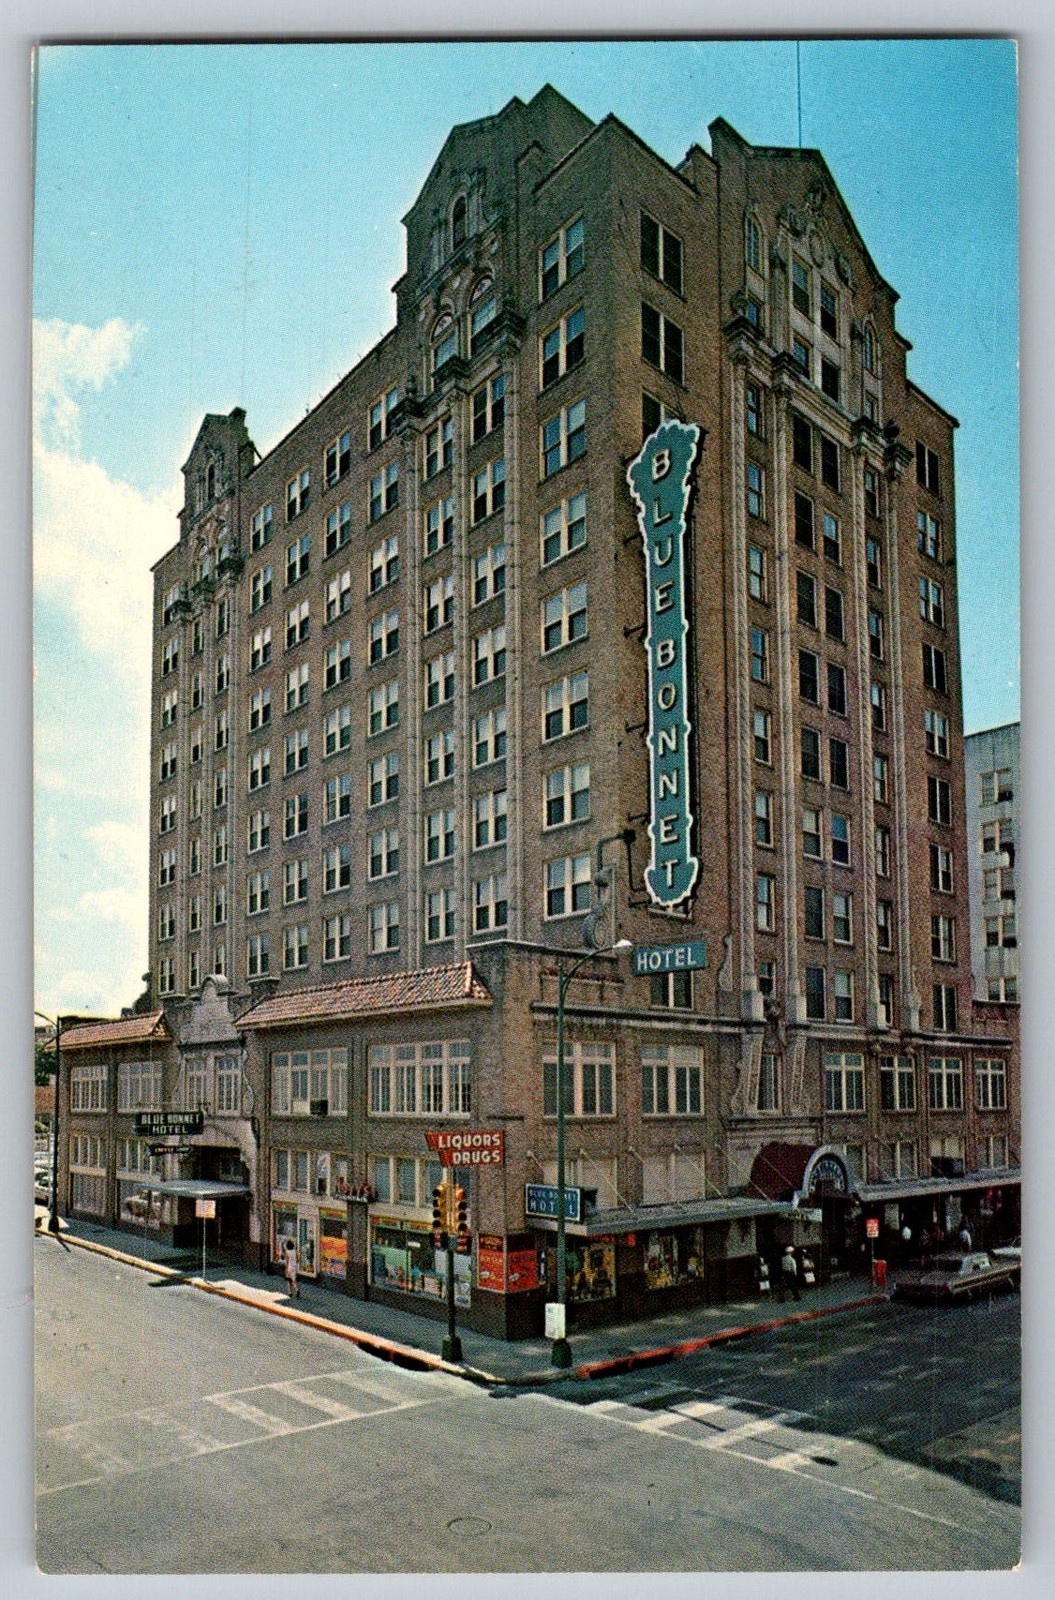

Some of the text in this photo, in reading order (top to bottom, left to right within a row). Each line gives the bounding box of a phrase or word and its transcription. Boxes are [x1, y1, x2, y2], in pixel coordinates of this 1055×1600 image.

[653, 448, 674, 613] BLUE
[656, 639, 678, 887] BONNET
[636, 946, 698, 971] HOTEL
[141, 1113, 200, 1125] BLUE BONNET
[152, 1125, 189, 1136] HOTEL
[438, 1134, 501, 1150] LIQUORS
[452, 1150, 501, 1165] DRUGS
[530, 1200, 576, 1216] HOTL
